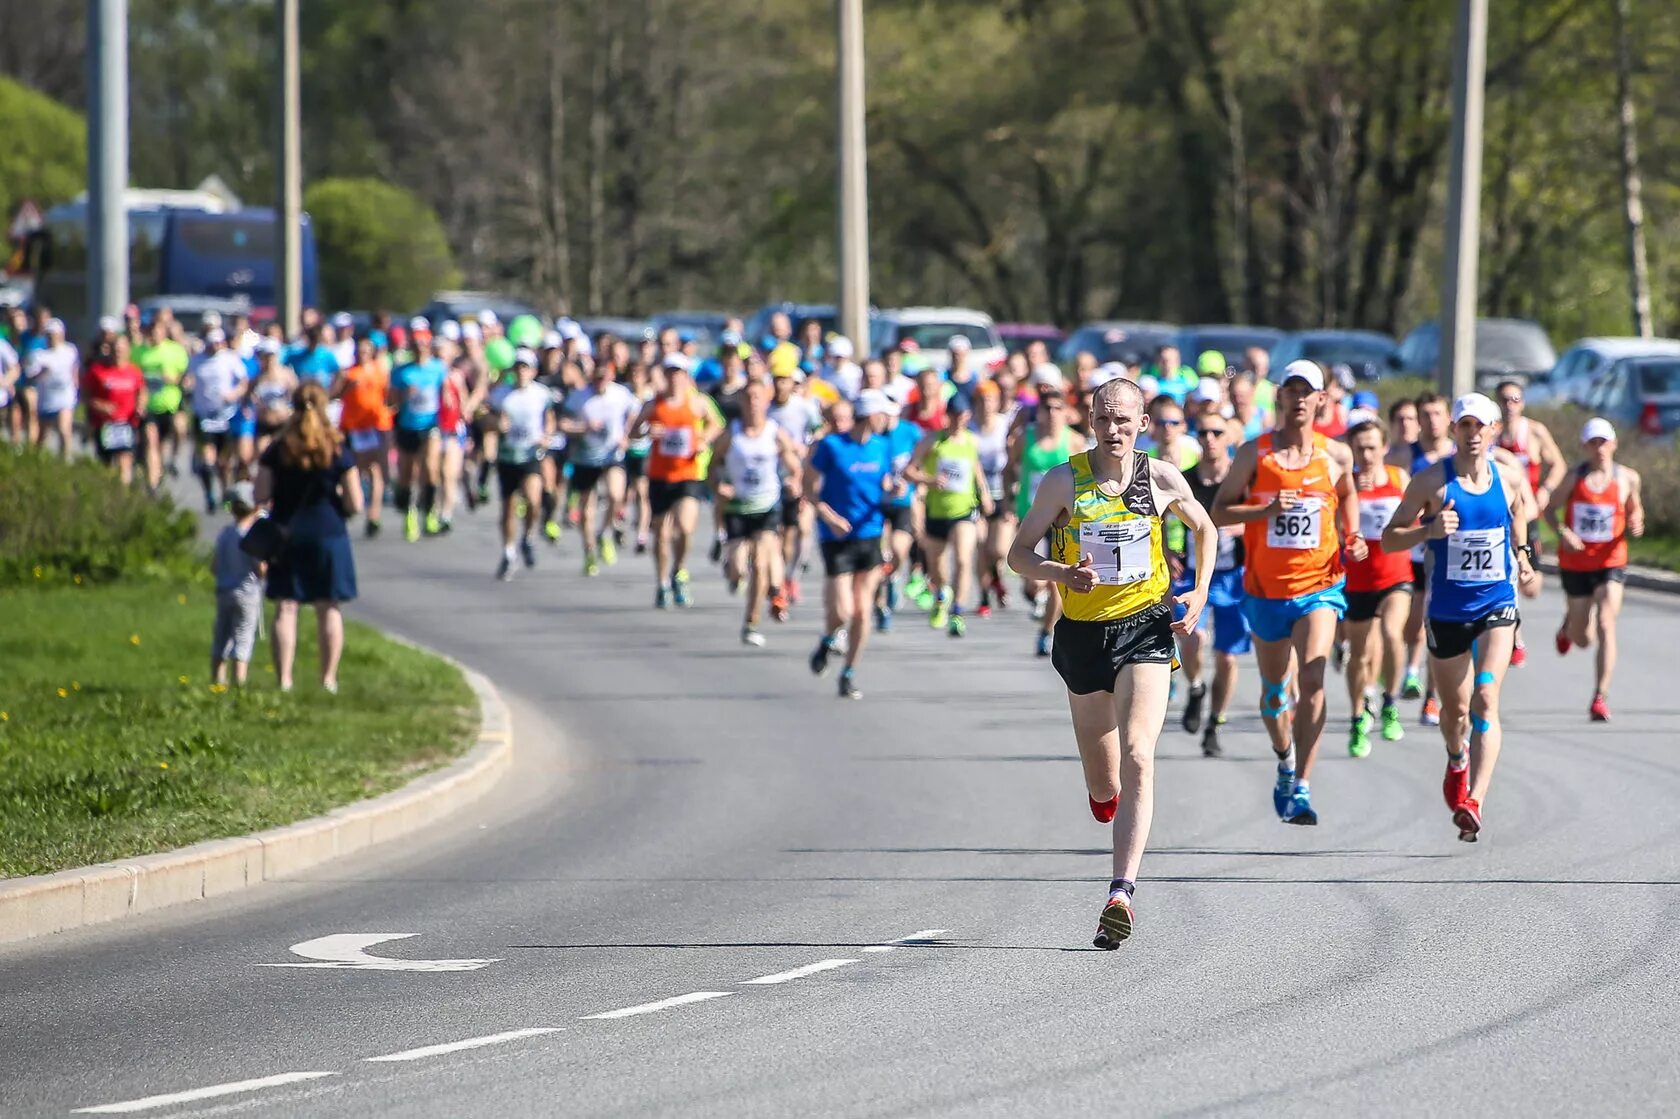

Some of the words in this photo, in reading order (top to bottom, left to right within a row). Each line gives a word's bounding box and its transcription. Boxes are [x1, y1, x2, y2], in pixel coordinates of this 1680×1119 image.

[1275, 515, 1311, 537] 562
[1111, 546, 1121, 572] 1
[1460, 549, 1493, 571] 212
